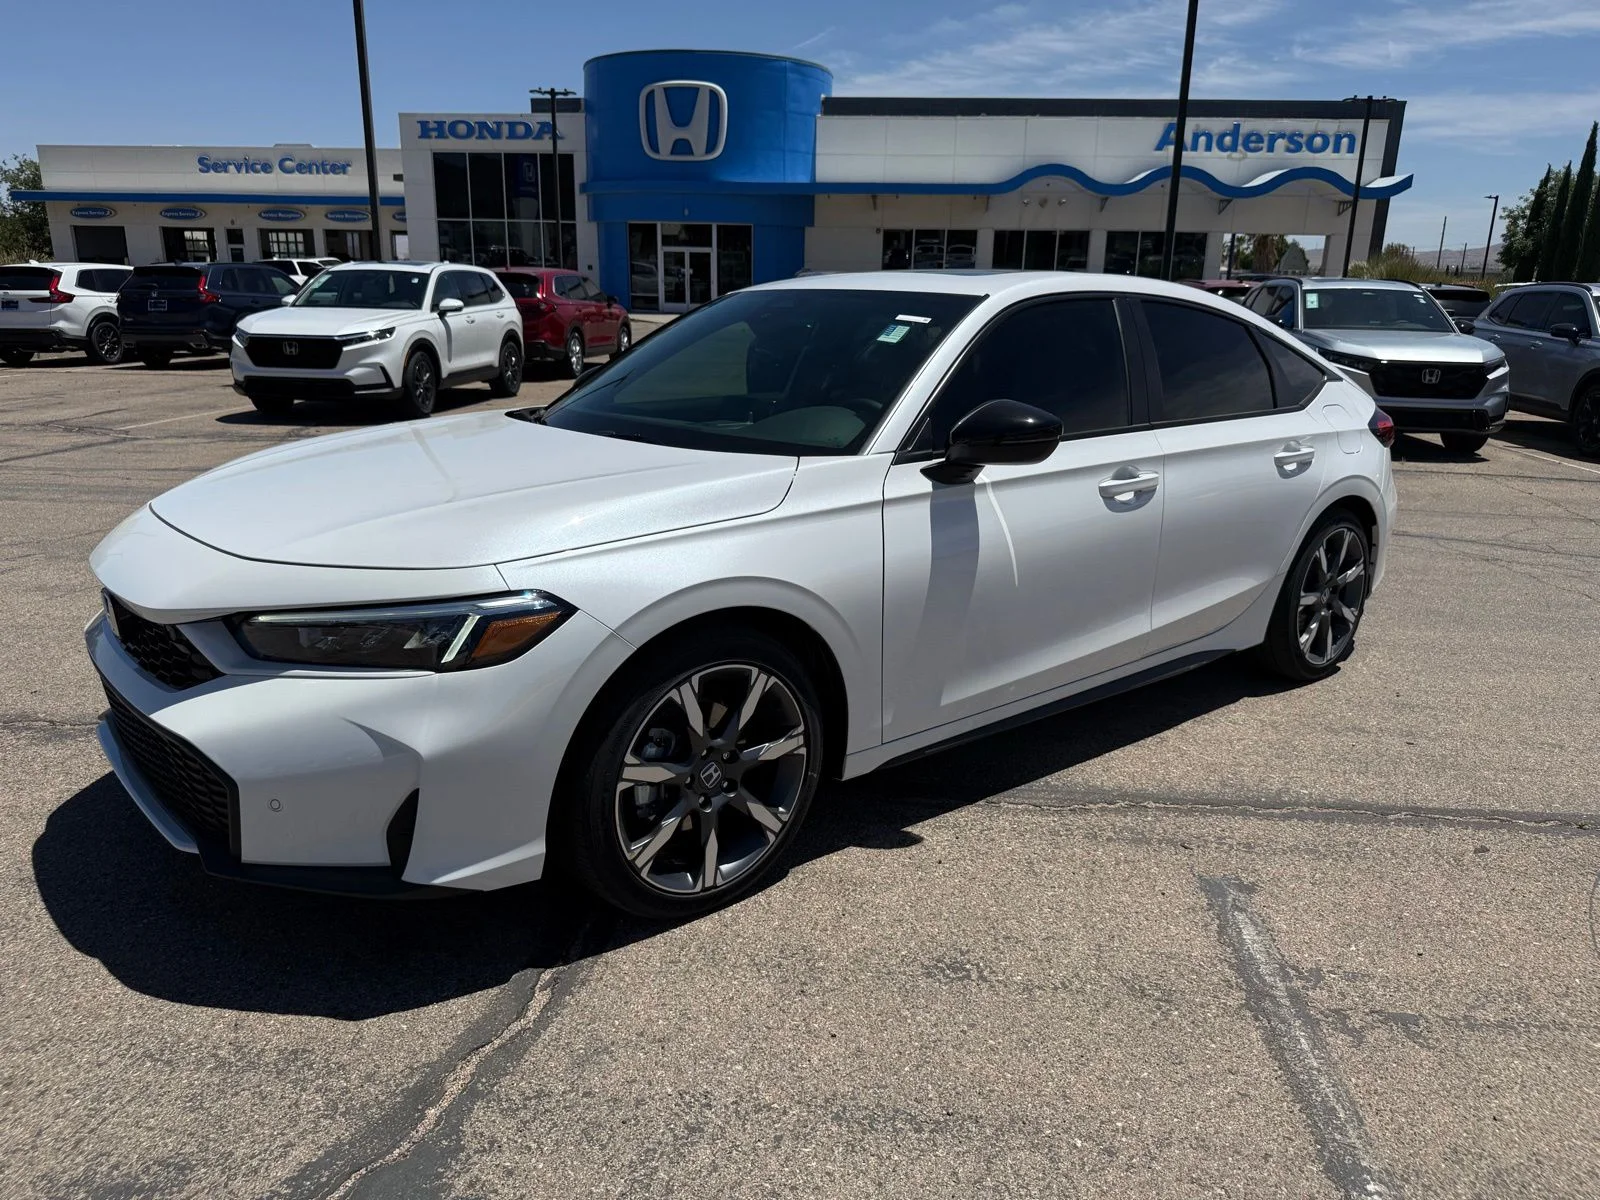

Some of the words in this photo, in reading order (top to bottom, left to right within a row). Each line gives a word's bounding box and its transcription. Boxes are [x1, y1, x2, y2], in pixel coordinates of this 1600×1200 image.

[416, 119, 565, 140] HONDA
[1154, 121, 1357, 154] Anderson
[197, 155, 274, 174] Service
[278, 156, 352, 175] Center
